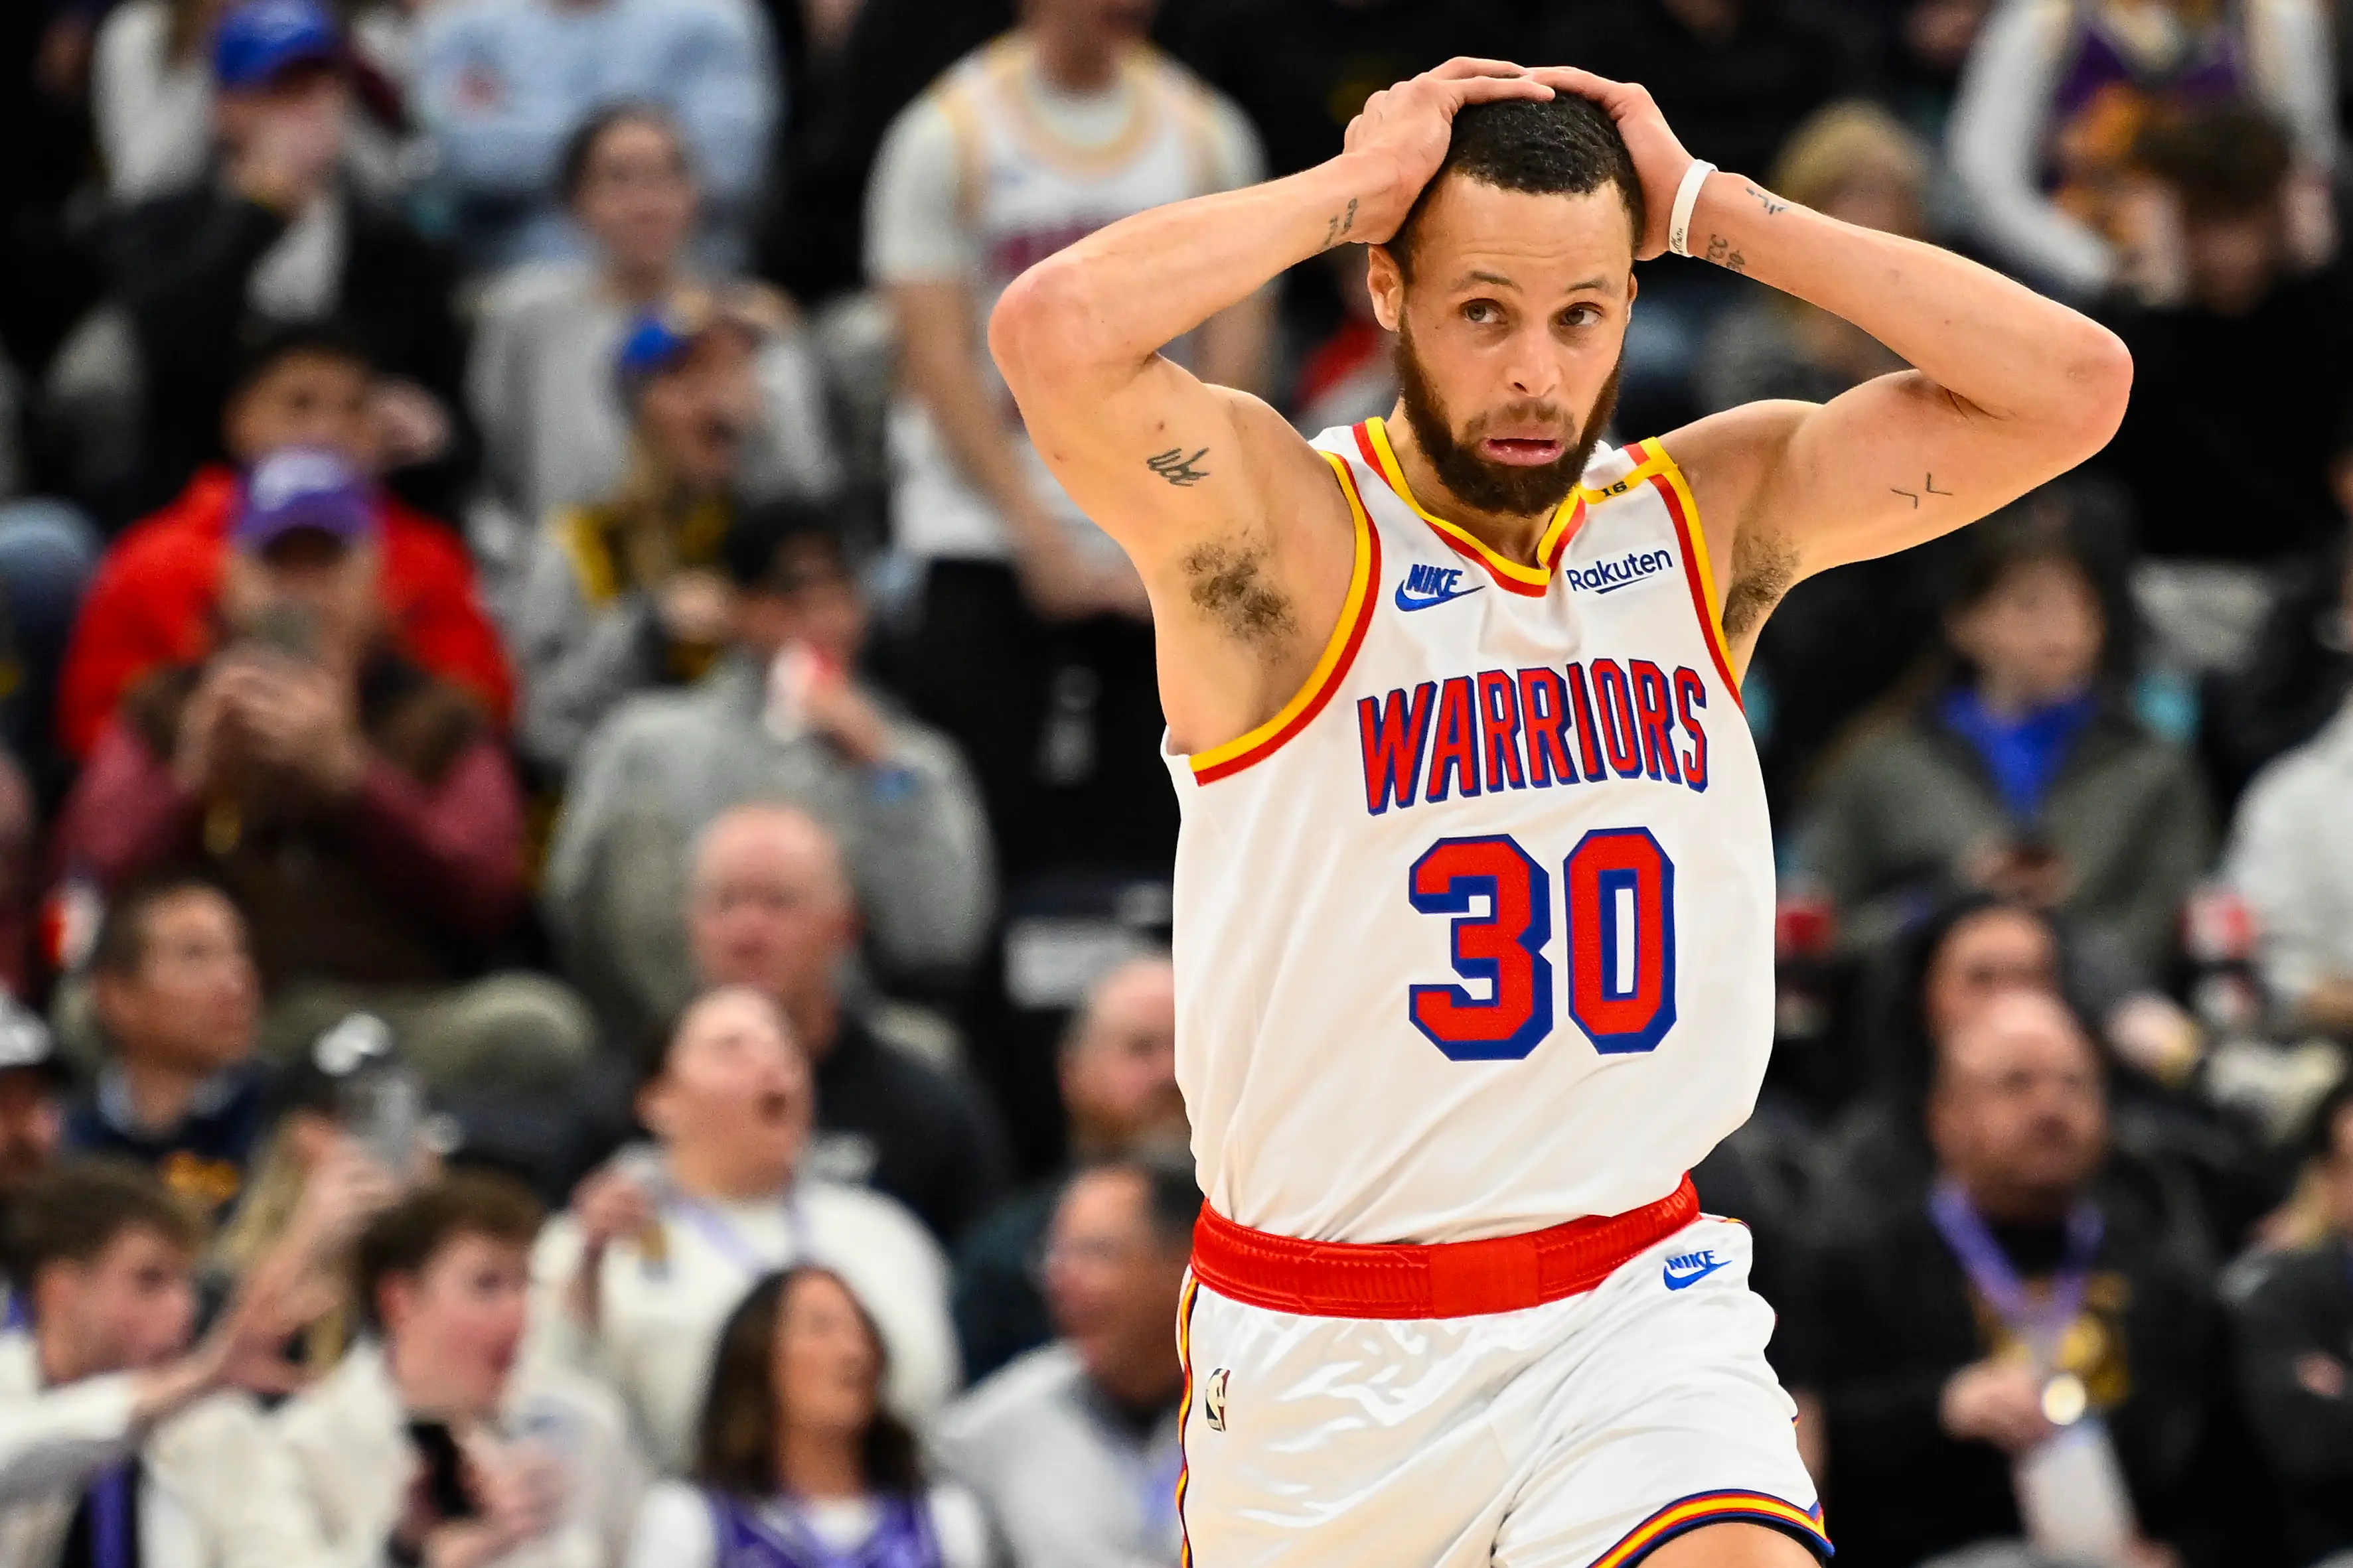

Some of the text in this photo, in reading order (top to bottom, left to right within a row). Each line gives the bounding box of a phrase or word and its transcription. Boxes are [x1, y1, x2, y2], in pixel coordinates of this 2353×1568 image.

[1602, 480, 1628, 497] 16
[1405, 563, 1464, 598] NIKE
[1565, 549, 1673, 592] Rakuten
[1357, 658, 1708, 816] WARRIORS
[1408, 826, 1677, 1062] 30
[1665, 1249, 1716, 1269] NIKE
